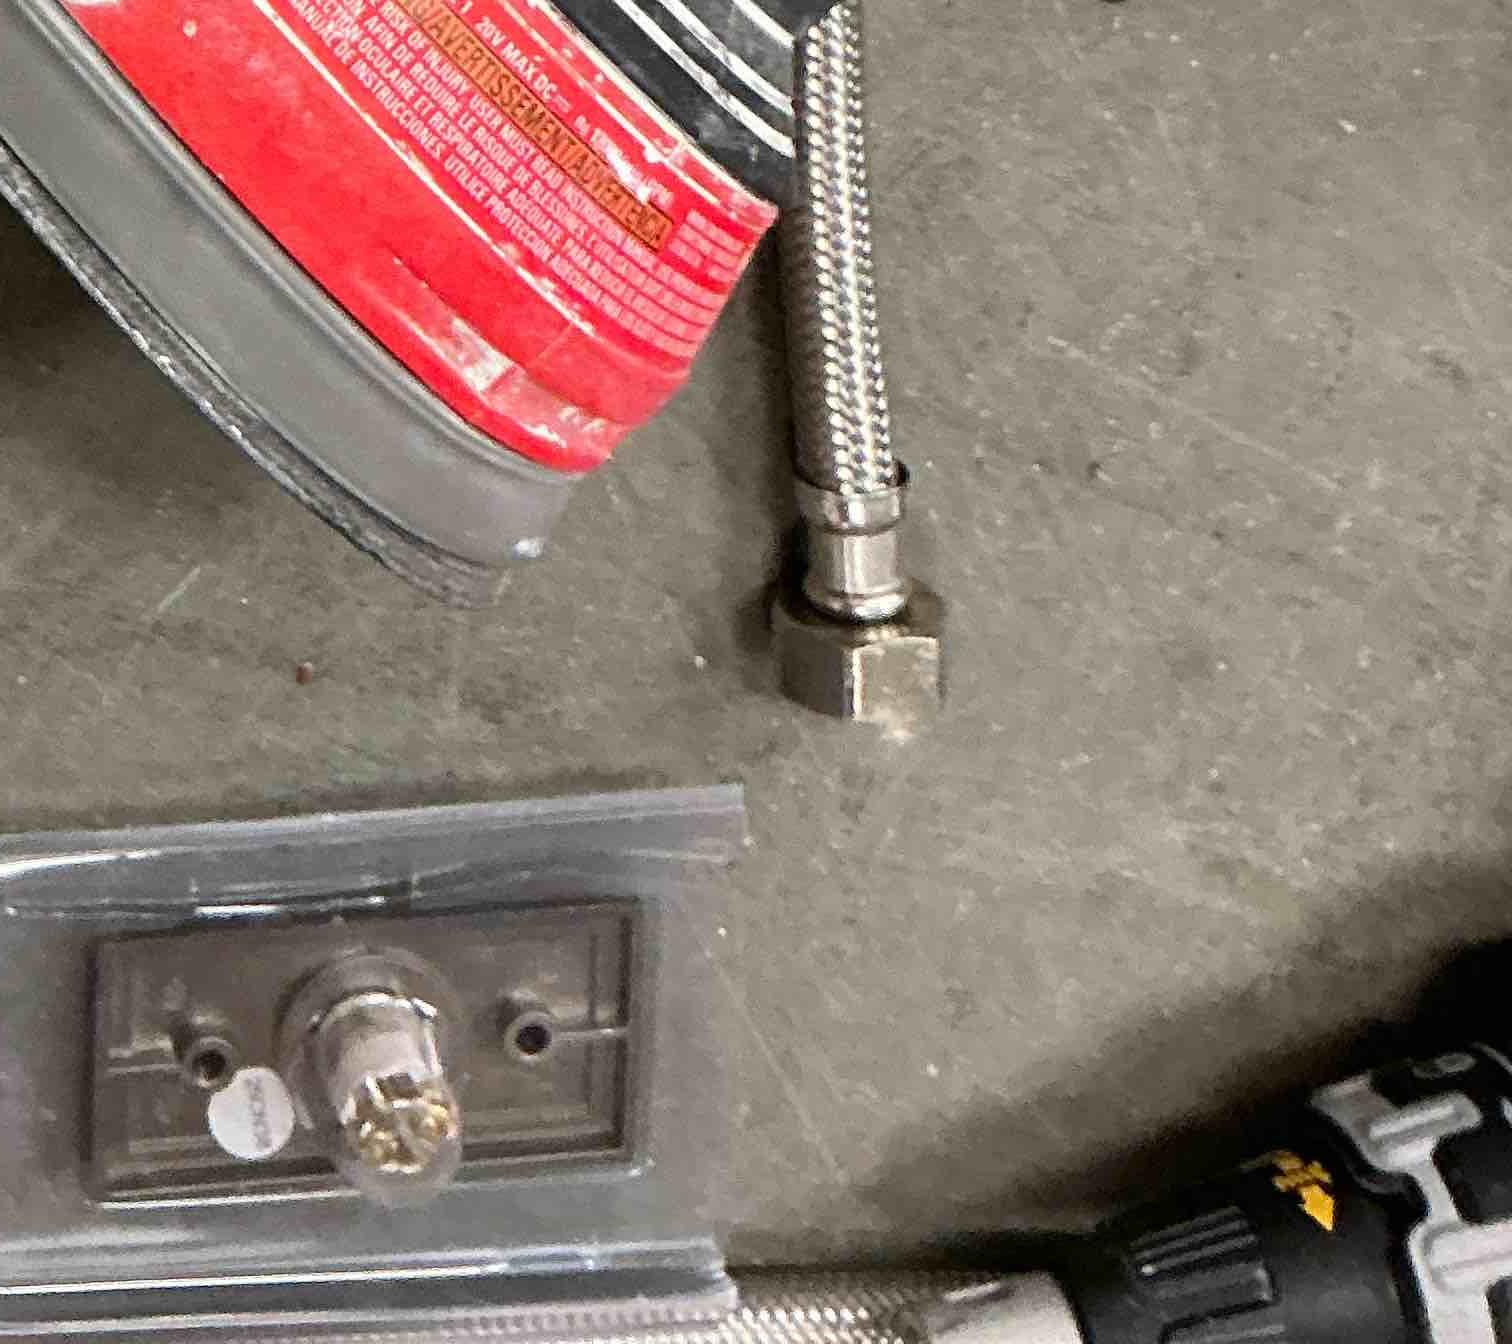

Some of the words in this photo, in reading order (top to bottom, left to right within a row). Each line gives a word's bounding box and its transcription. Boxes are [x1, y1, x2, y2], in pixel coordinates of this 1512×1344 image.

[331, 39, 358, 65] DE
[440, 152, 492, 203] UTILICE
[355, 34, 420, 101] OCULAIRE
[411, 93, 435, 118] ET
[426, 110, 513, 195] RESPIRATOIRE
[362, 12, 400, 51] AFIN
[390, 42, 416, 68] DE
[455, 110, 479, 134] LE
[469, 124, 518, 172] RISQUE
[509, 164, 534, 188] DE
[404, 28, 429, 53] OF
[465, 91, 505, 131] USER
[496, 122, 538, 163] MUST
[473, 14, 507, 48] 20V
[498, 39, 540, 82] MAX
[530, 71, 560, 101] DC
